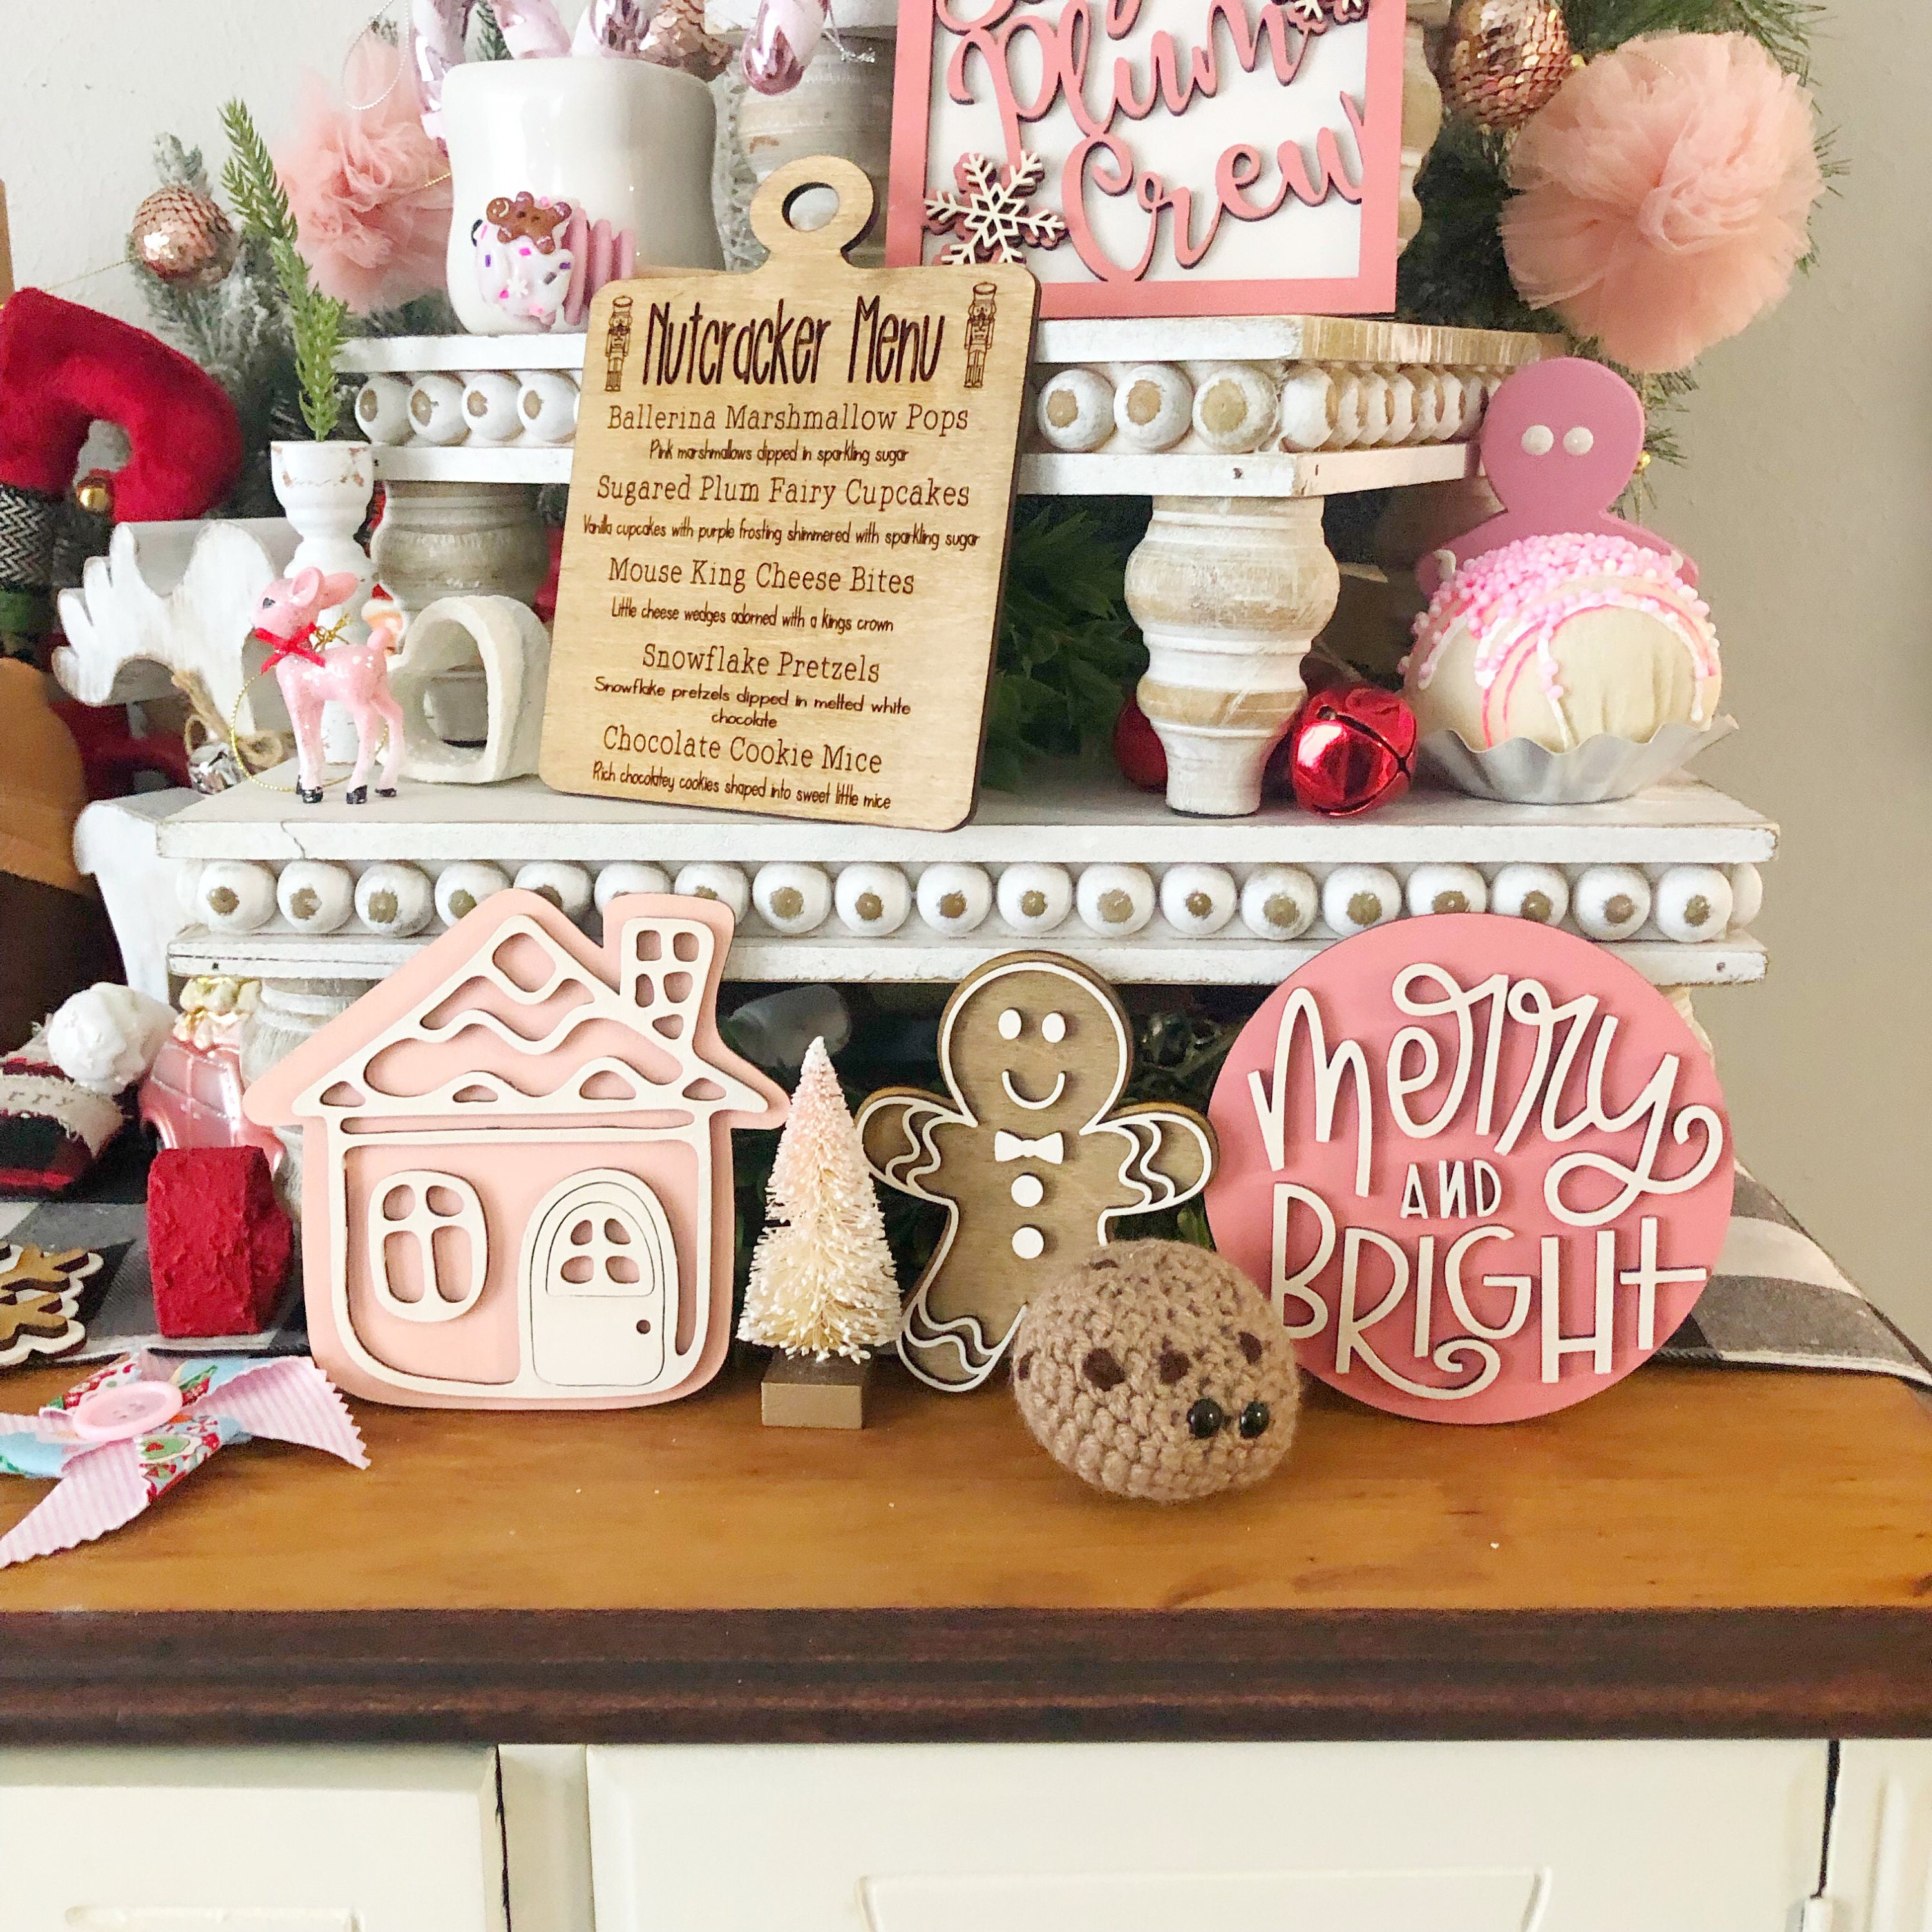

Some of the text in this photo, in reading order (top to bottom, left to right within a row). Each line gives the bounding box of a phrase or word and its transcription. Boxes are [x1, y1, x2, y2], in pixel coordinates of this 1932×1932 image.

[1061, 91, 1365, 281] Crew
[643, 295, 945, 386] Nutcracker Menu
[607, 403, 968, 437] Ballerina Marshmallow Pops
[650, 439, 909, 467] Pink marshmallows dipped in sparkling sugar
[598, 474, 969, 512] Sugared Plum Fairy Cupcakes
[616, 516, 666, 540] cupcakes
[672, 516, 694, 537] with
[698, 518, 734, 543] purple
[739, 518, 782, 545] frosting
[787, 520, 851, 543] shimmered
[856, 522, 879, 544] with
[885, 522, 940, 551] sparkling
[945, 534, 980, 551] sugar
[609, 557, 914, 594] Mouse King Cheese Bites
[612, 597, 636, 618] Little
[641, 598, 679, 620] cheese
[684, 601, 726, 627] wedges
[731, 603, 778, 626] adorned
[782, 606, 804, 627] with
[811, 616, 817, 629] a
[857, 619, 893, 632] crown
[643, 643, 879, 683] Snowflake Pretzels
[594, 676, 911, 715] Snowflake pretzels dipped in melted white
[712, 708, 777, 728] chocolate
[604, 724, 882, 773] Chocolate Cookie Mice
[593, 761, 891, 810] Rich chocolatey cookies shaped into sweet little mice
[1399, 1159, 1502, 1219] AND
[1270, 1182, 1707, 1400] BRIGHT
